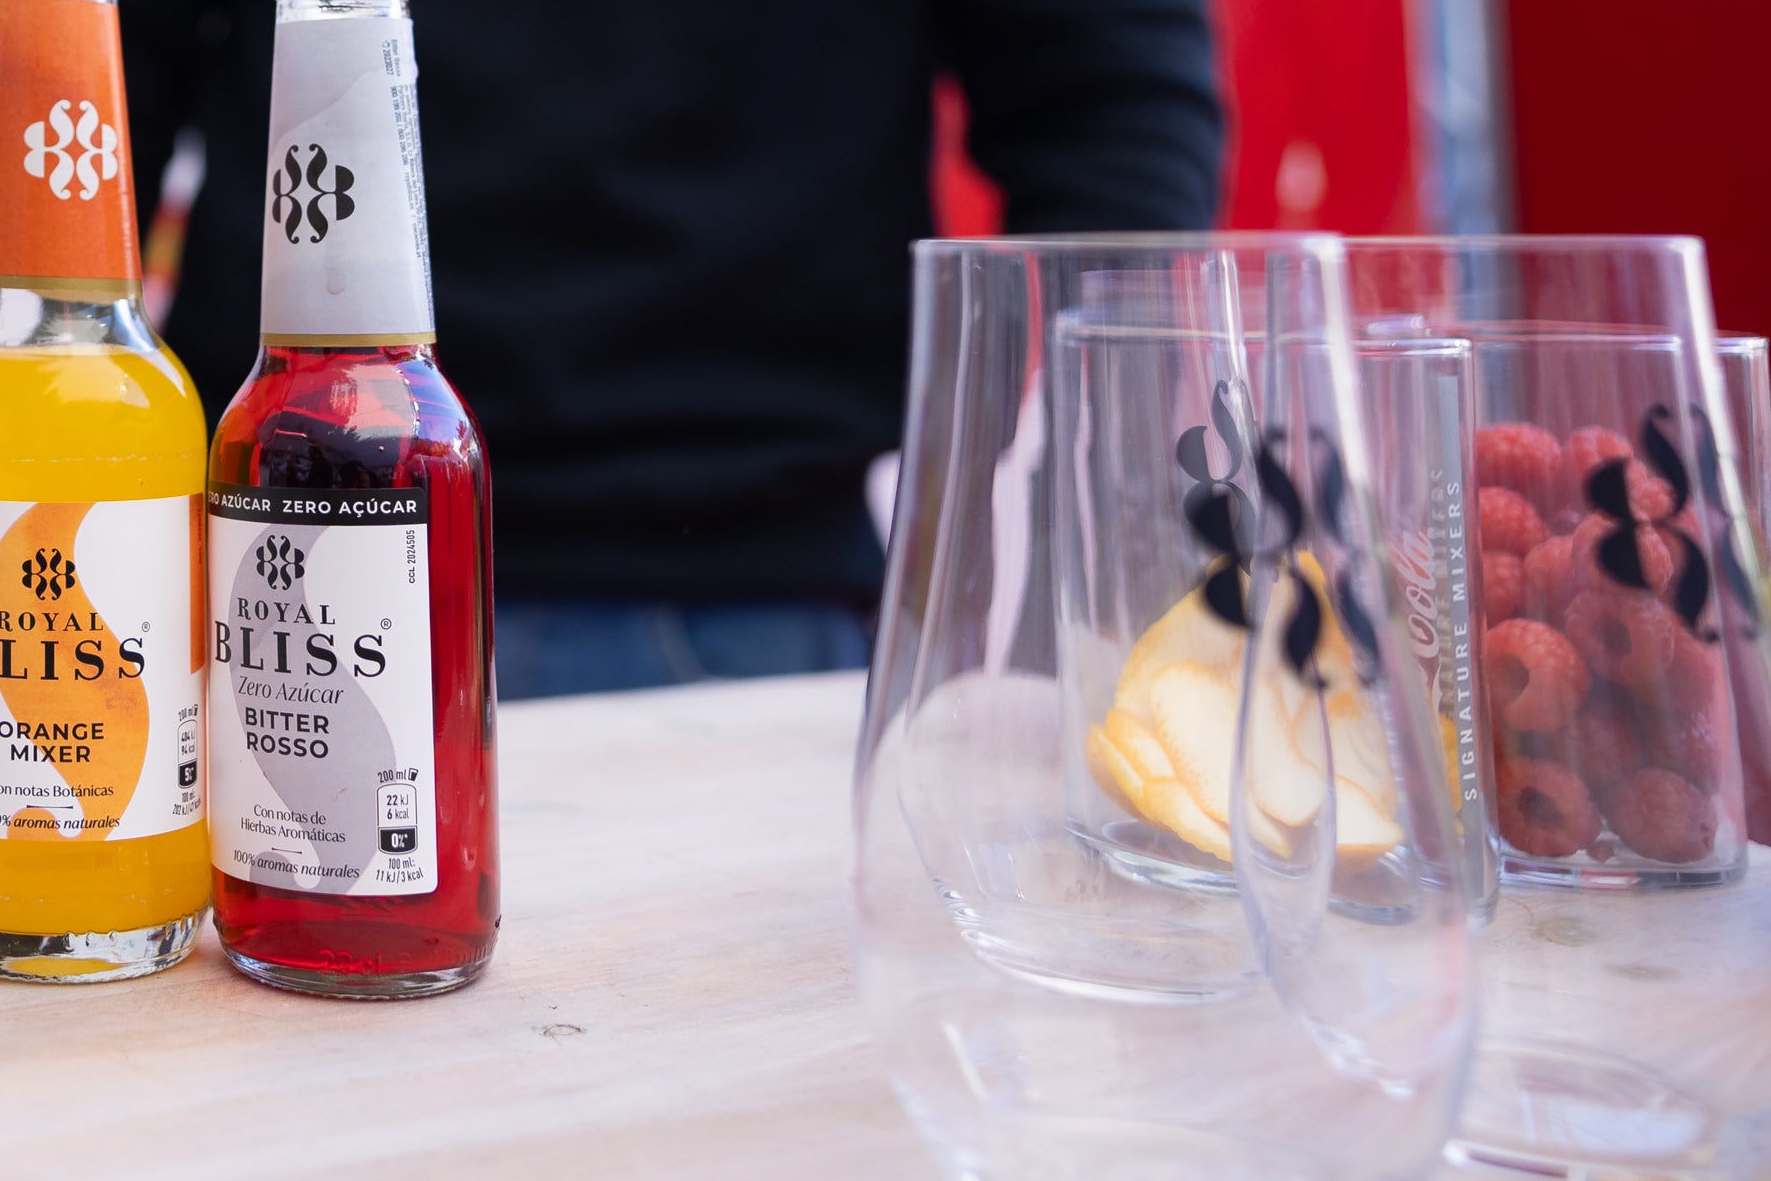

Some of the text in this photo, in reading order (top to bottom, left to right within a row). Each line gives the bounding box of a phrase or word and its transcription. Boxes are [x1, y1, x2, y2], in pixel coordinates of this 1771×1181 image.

[221, 493, 271, 512] AZÚCAR
[283, 500, 331, 515] ZERO
[339, 498, 417, 518] AÇÚCAR
[406, 529, 416, 584] CCL 2024505
[237, 597, 336, 625] ROYAL
[215, 620, 386, 677] BLISS
[1447, 481, 1478, 802] SIGNATURE MIXERS
[238, 675, 344, 704] Zero Azúcar
[245, 707, 329, 734] BITTER
[10, 744, 91, 763] MIXER
[246, 732, 329, 759] ROSSO
[377, 768, 407, 783] 200 ml
[15, 784, 50, 798] notas
[53, 784, 114, 798] Botánicas
[387, 794, 409, 806] 22 kJ
[13, 816, 61, 830] aromas
[64, 814, 120, 830] naturales
[253, 803, 326, 825] Con notas de
[387, 808, 409, 820] 6 kcal
[241, 817, 346, 843] Hierbas Aromáticas
[233, 849, 360, 879] 100% aromas naturales
[376, 869, 385, 882] 11
[407, 867, 423, 881] kcal
[388, 857, 400, 870] 100
